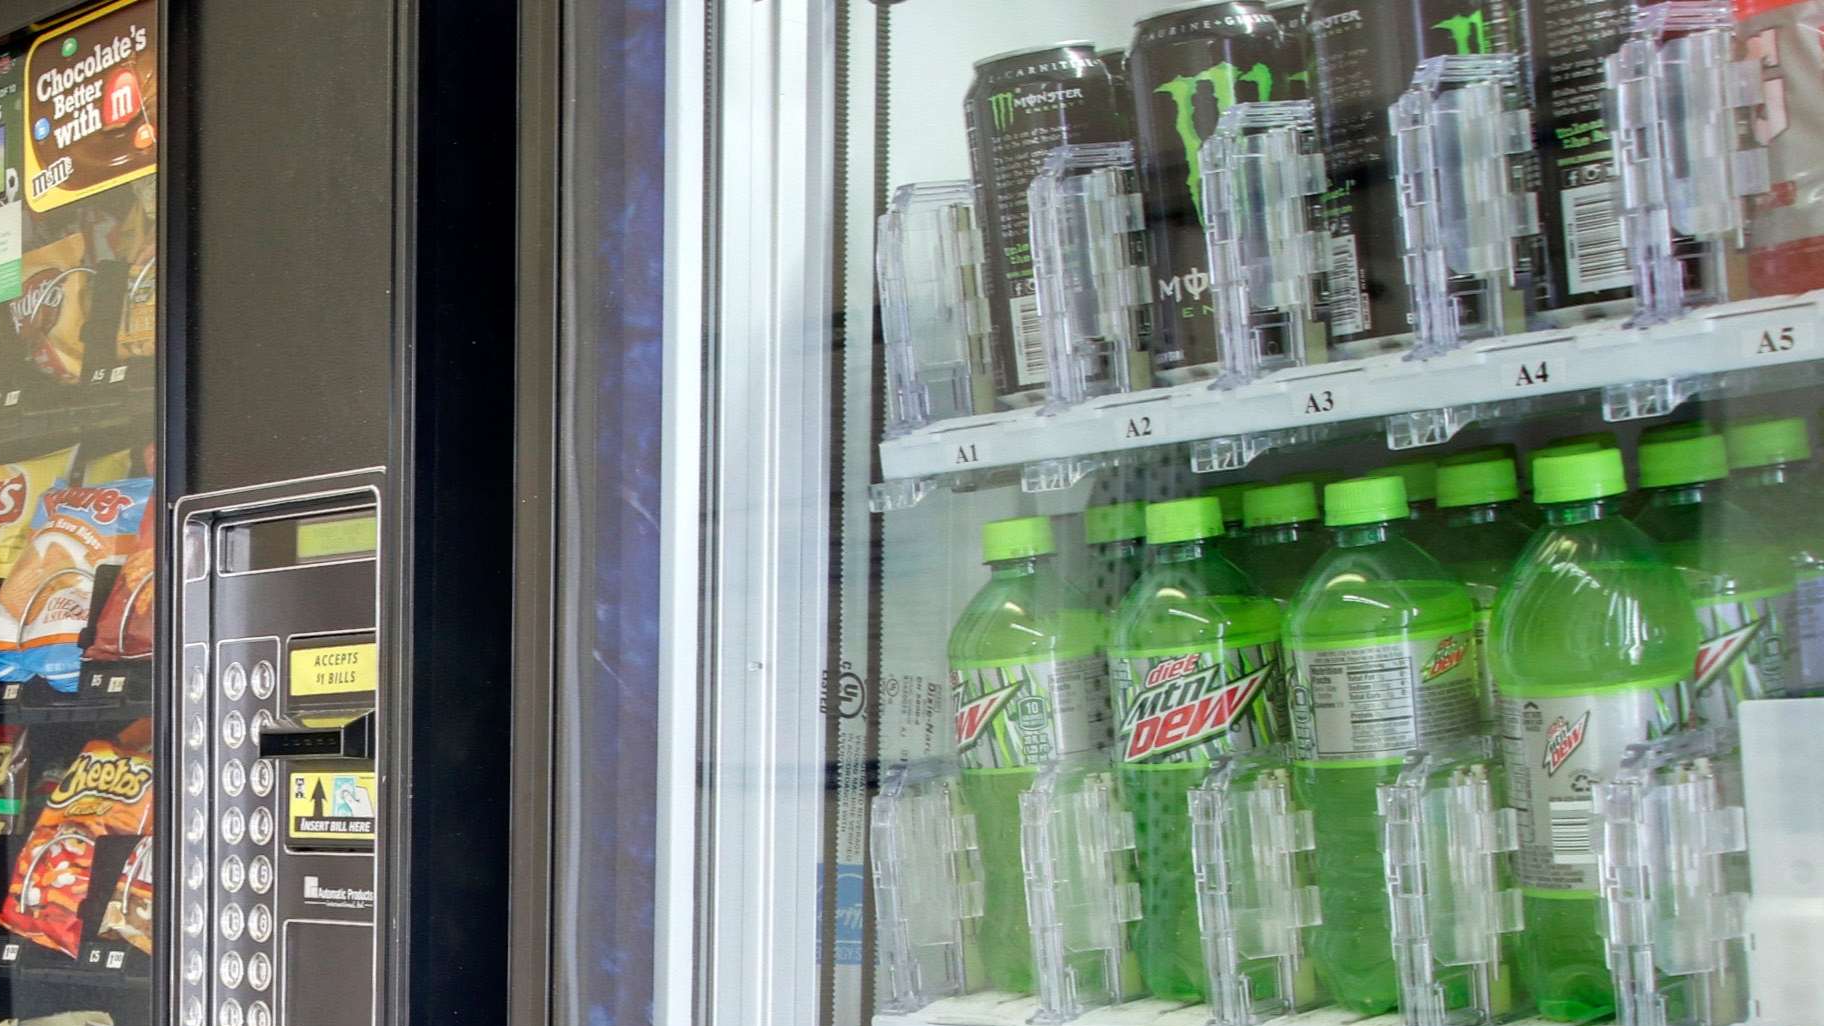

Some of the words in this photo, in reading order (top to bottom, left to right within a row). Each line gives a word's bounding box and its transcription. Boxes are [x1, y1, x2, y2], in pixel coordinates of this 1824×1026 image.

[35, 25, 148, 102] Chocolate's
[53, 79, 104, 119] Better
[1014, 88, 1084, 108] MONSTER
[54, 107, 103, 150] with
[1757, 328, 1794, 355] A5
[1515, 362, 1549, 387] A4
[1305, 391, 1335, 416] A3
[1124, 415, 1153, 438] A2
[954, 442, 979, 465] A1
[314, 652, 358, 667] ACCEPTS
[1146, 653, 1200, 689] diet
[328, 671, 356, 685] BILLS
[51, 754, 151, 803] Cheetos
[300, 818, 330, 832] INSERT
[330, 820, 348, 832] BILL
[348, 821, 371, 833] HERE
